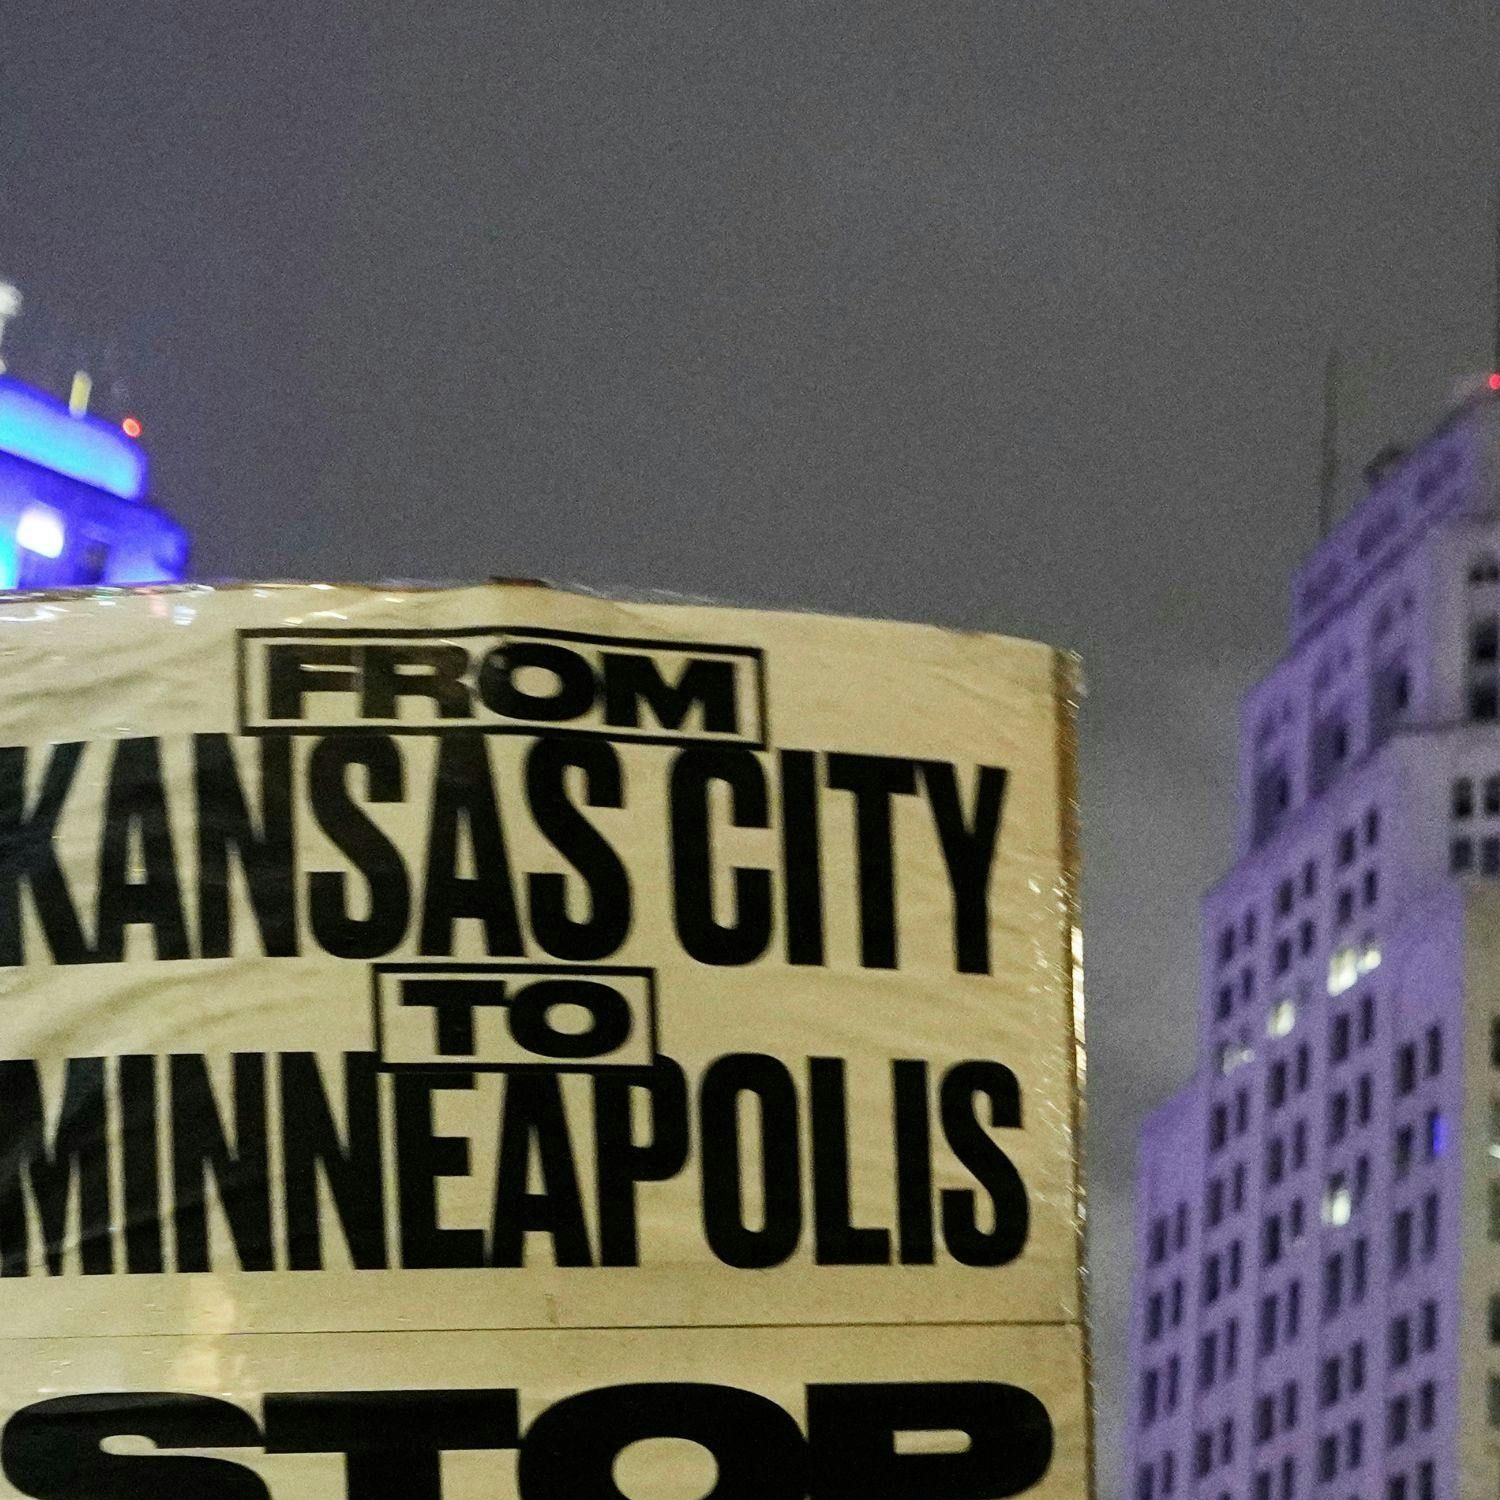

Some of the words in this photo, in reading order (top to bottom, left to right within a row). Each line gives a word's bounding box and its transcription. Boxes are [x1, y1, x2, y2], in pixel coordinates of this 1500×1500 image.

[265, 643, 739, 734] FROM
[0, 732, 632, 966] KANSAS
[668, 748, 1009, 975] CITY
[400, 978, 631, 1060] TO
[0, 1050, 1028, 1278] MINNEAPOLIS
